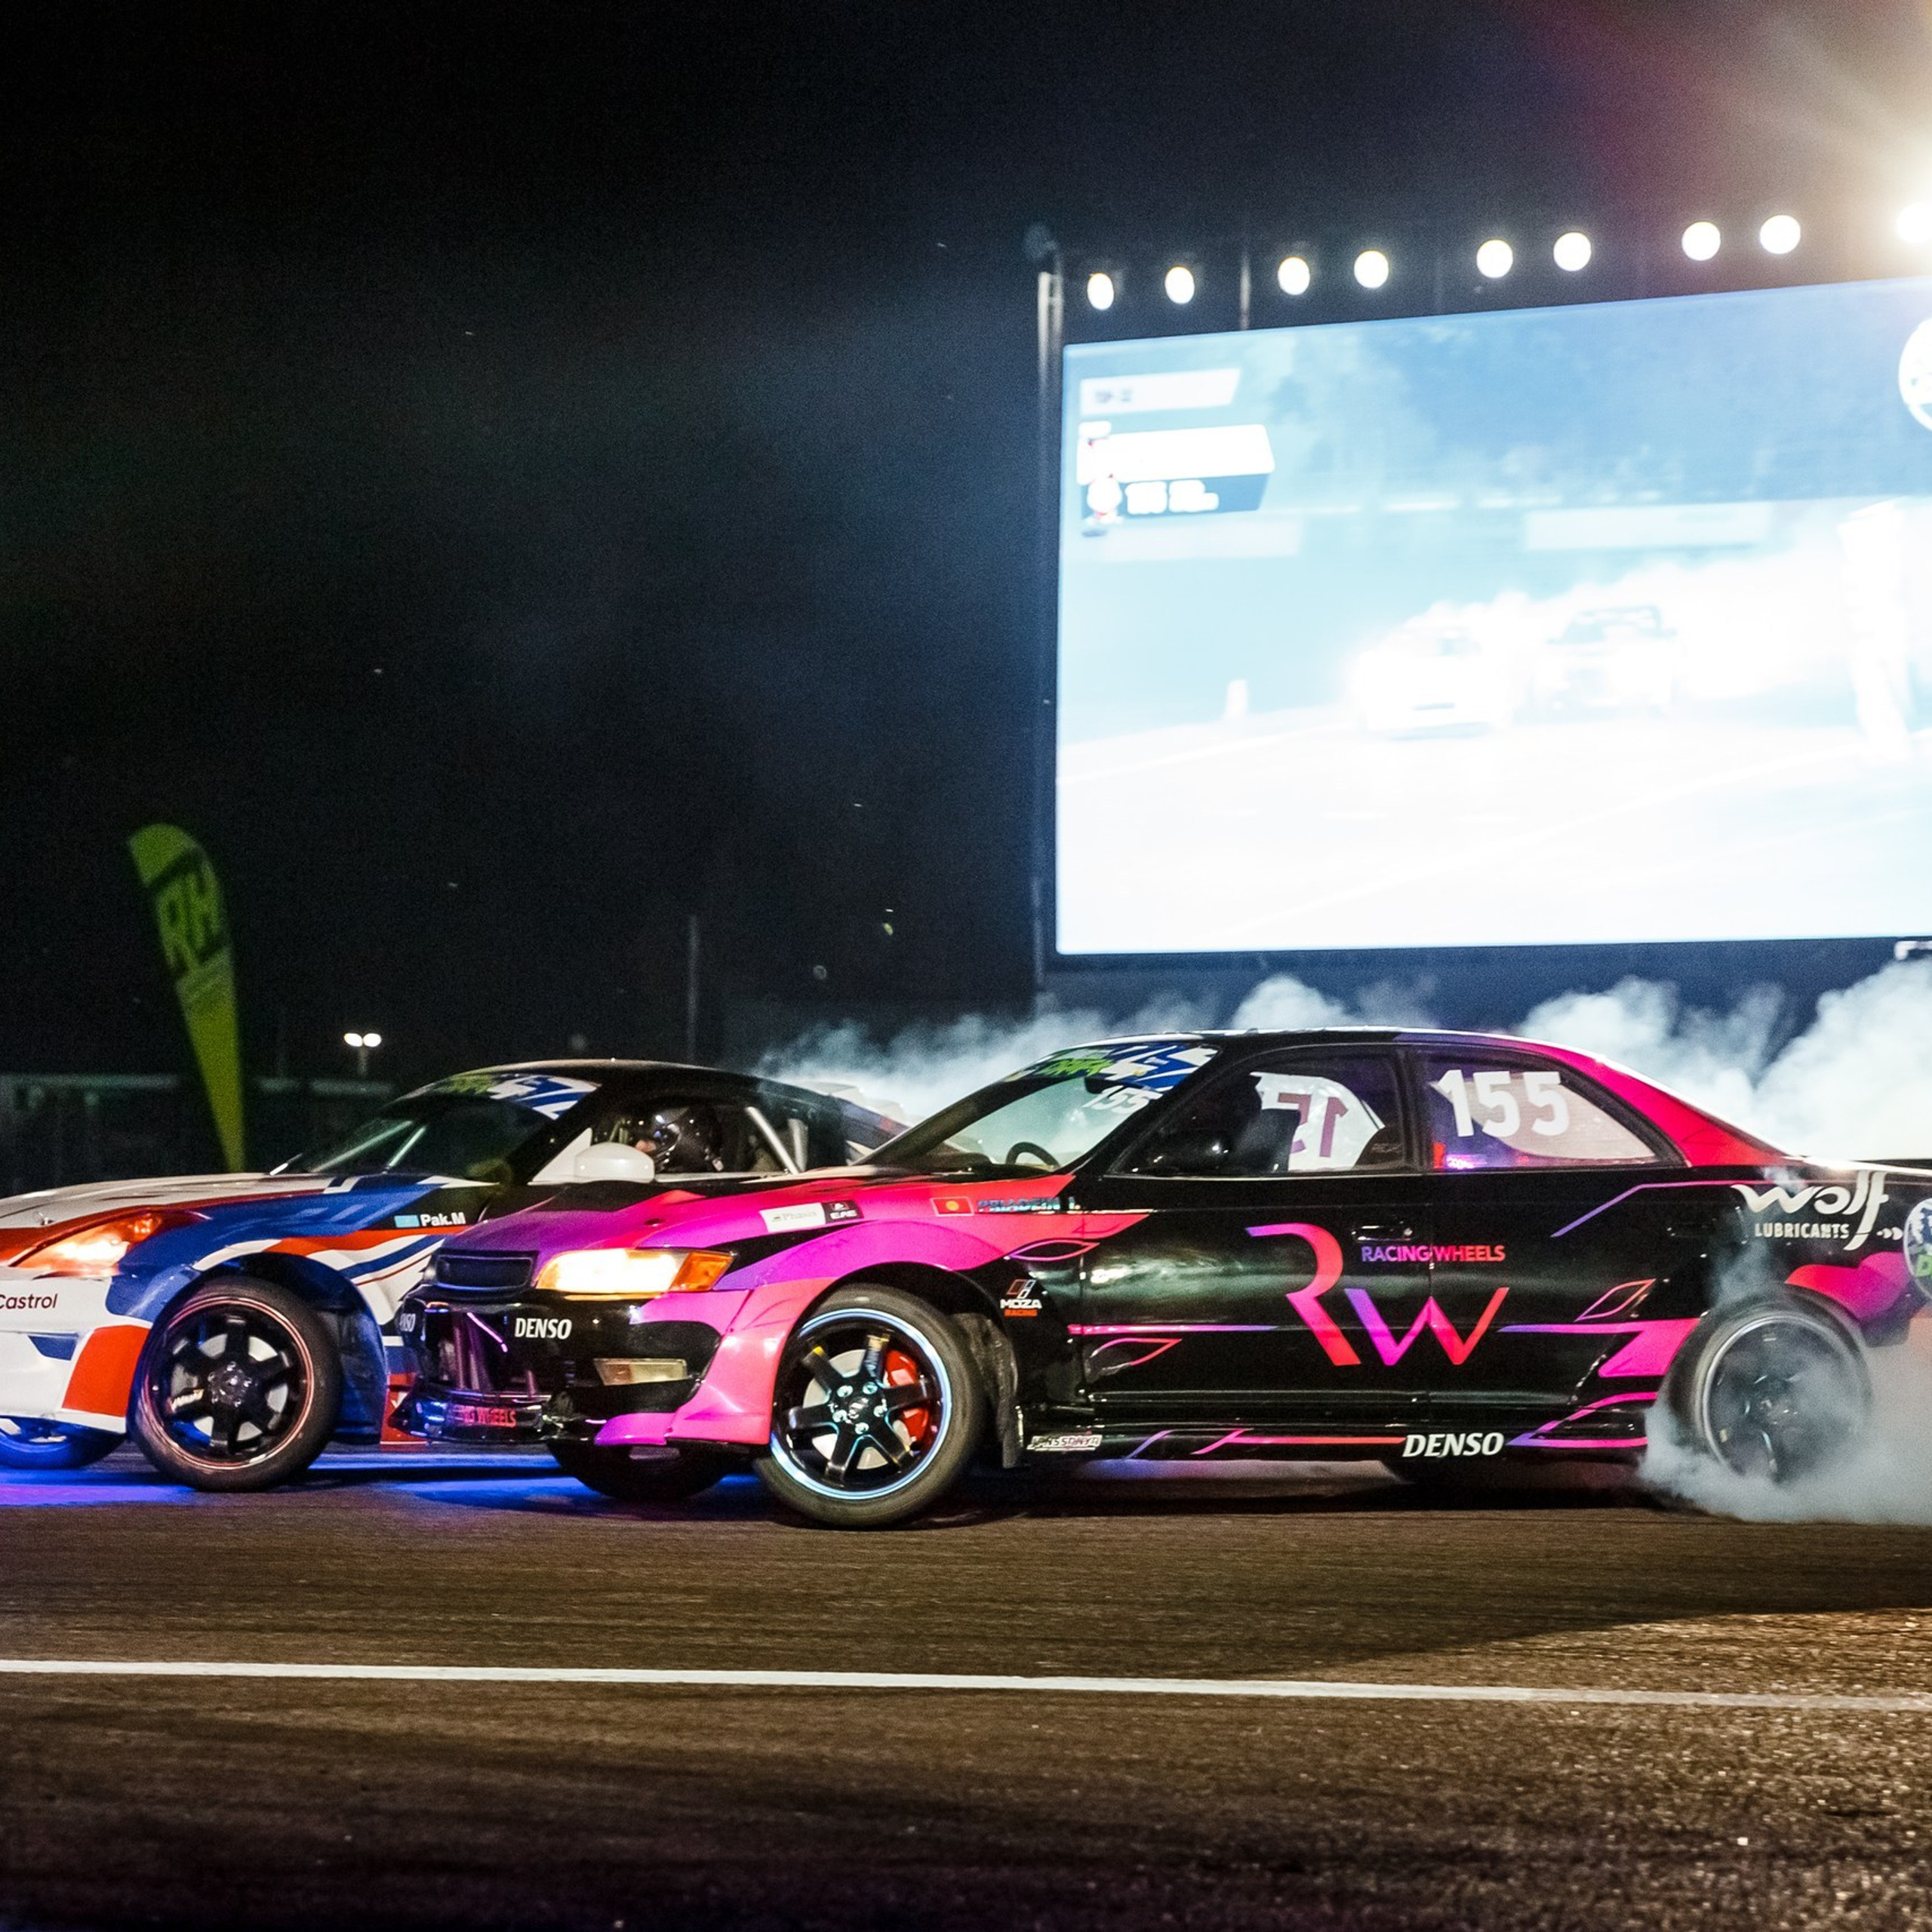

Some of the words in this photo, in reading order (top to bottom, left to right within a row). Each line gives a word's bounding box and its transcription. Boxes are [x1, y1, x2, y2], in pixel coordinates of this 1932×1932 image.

[1082, 1085, 1163, 1114] 155
[1437, 1069, 1569, 1137] 155
[420, 1212, 466, 1226] Pak.M
[1755, 1223, 1849, 1238] LUBRICANTS
[1361, 1245, 1431, 1262] RACING
[1434, 1245, 1506, 1262] WHEELS
[0, 1293, 58, 1309] Castrol
[1000, 1299, 1042, 1309] MOZA
[515, 1318, 572, 1340] DENSO
[1402, 1432, 1505, 1458] DENSO
